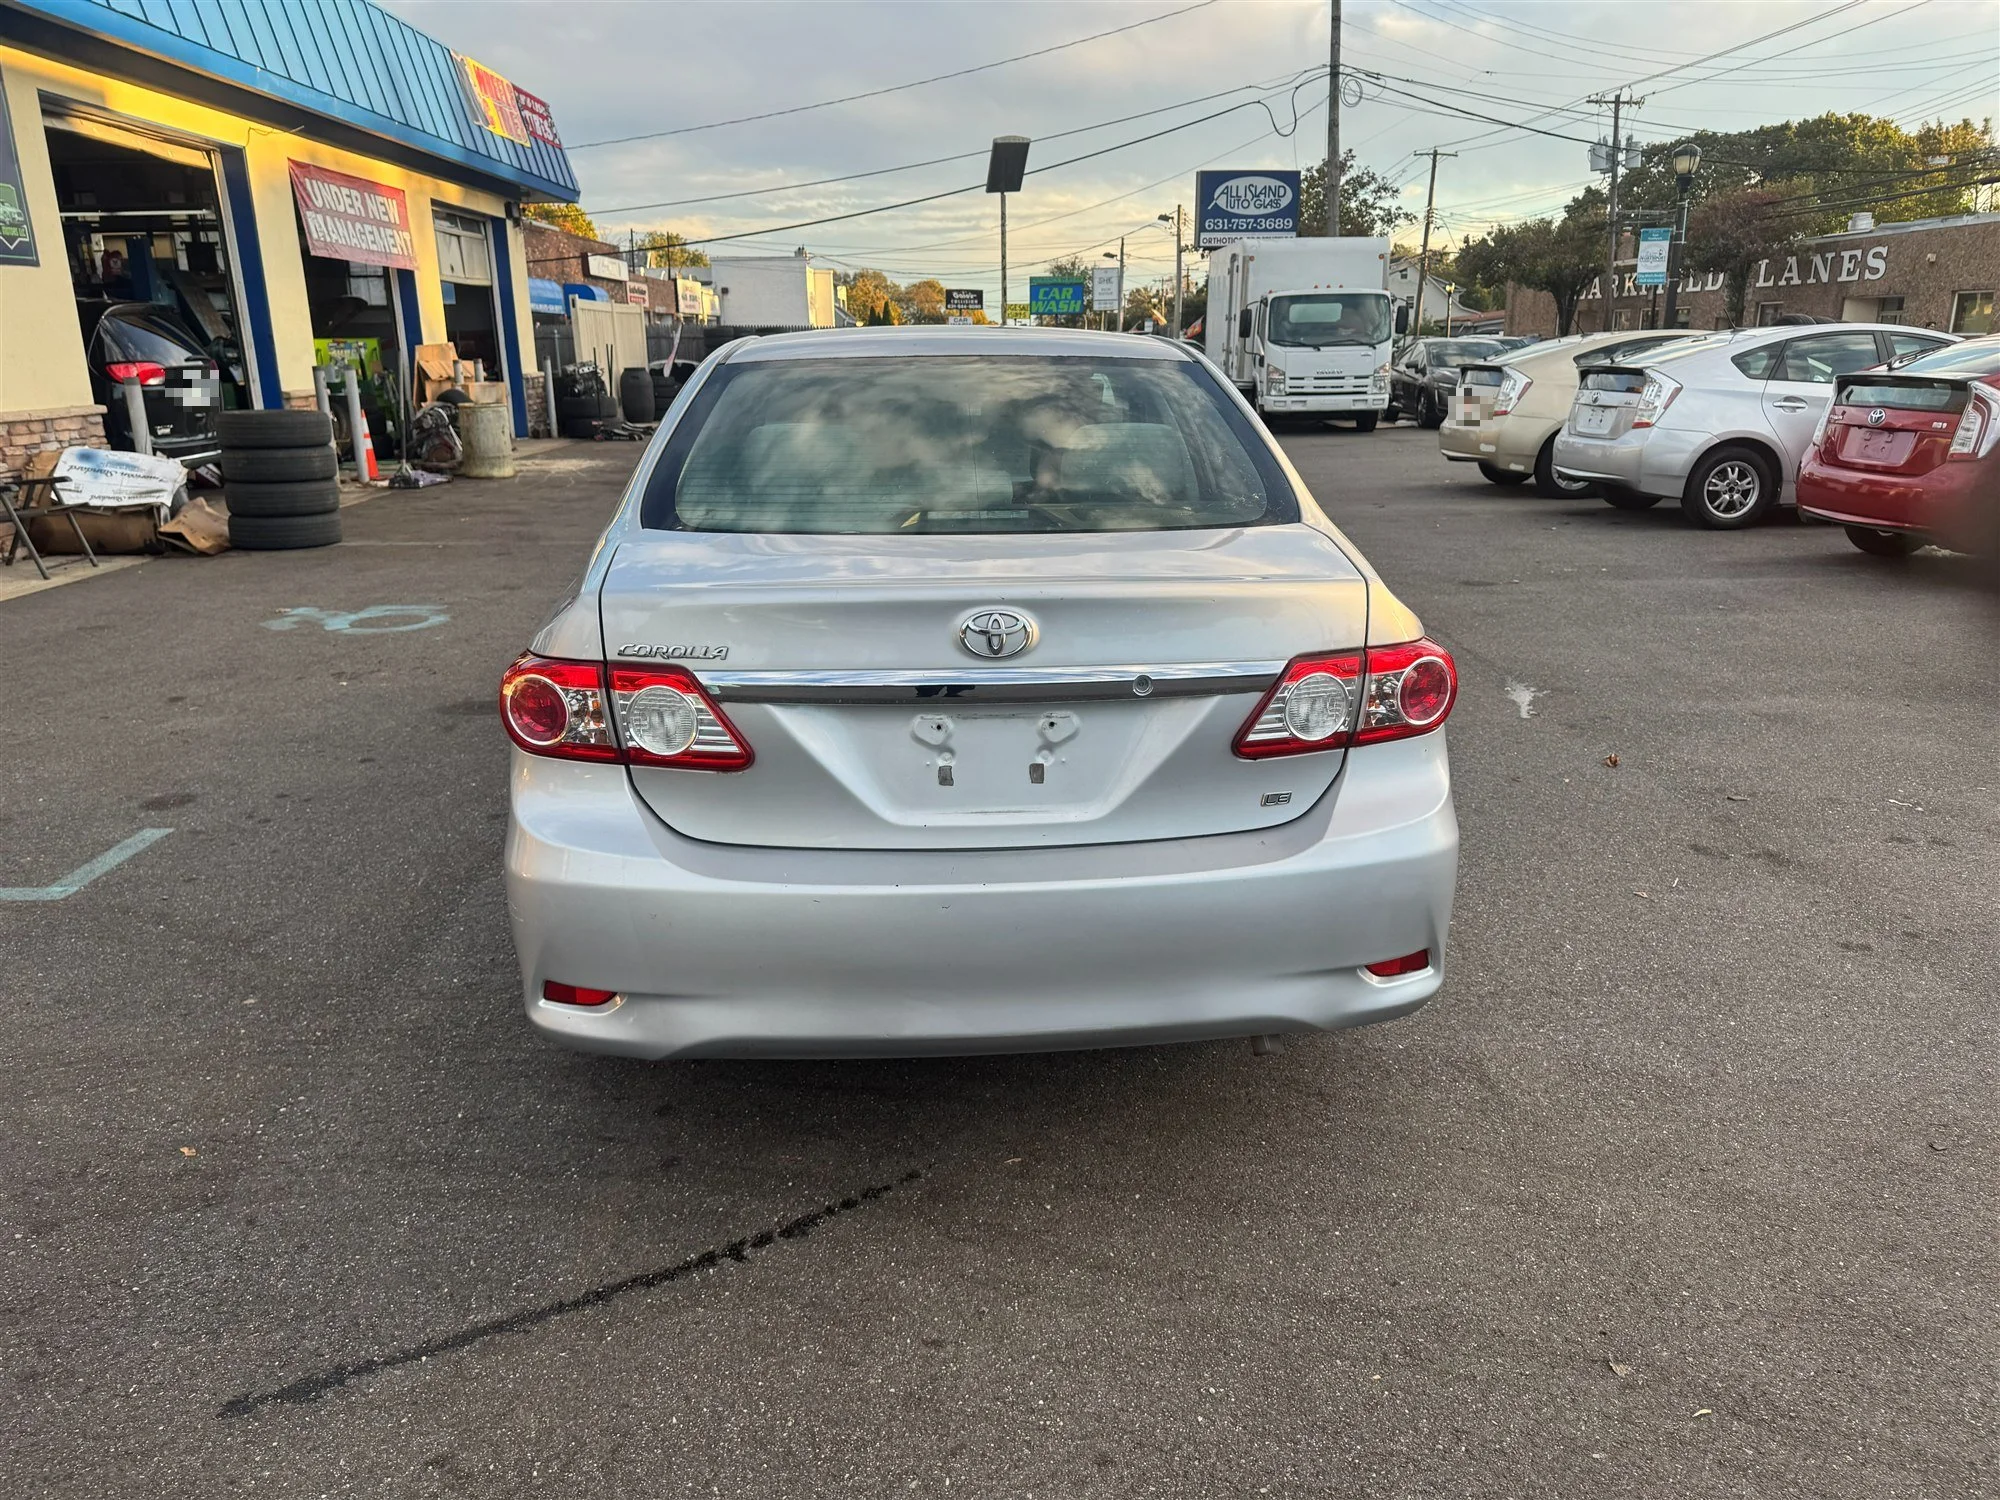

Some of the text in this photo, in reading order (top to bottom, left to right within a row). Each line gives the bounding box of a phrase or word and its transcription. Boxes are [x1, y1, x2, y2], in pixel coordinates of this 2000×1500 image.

[1245, 184, 1286, 200] ISLAND
[304, 178, 399, 225] UNDER NEW
[1254, 199, 1281, 209] GLASS
[1205, 218, 1293, 230] 631-757-3689
[305, 211, 413, 256] MANAGEMENT
[1756, 246, 1888, 288] LANES
[1038, 287, 1073, 300] CAR
[1031, 300, 1082, 313] WASH
[617, 643, 729, 660] COROLLA
[1263, 792, 1291, 806] LE
